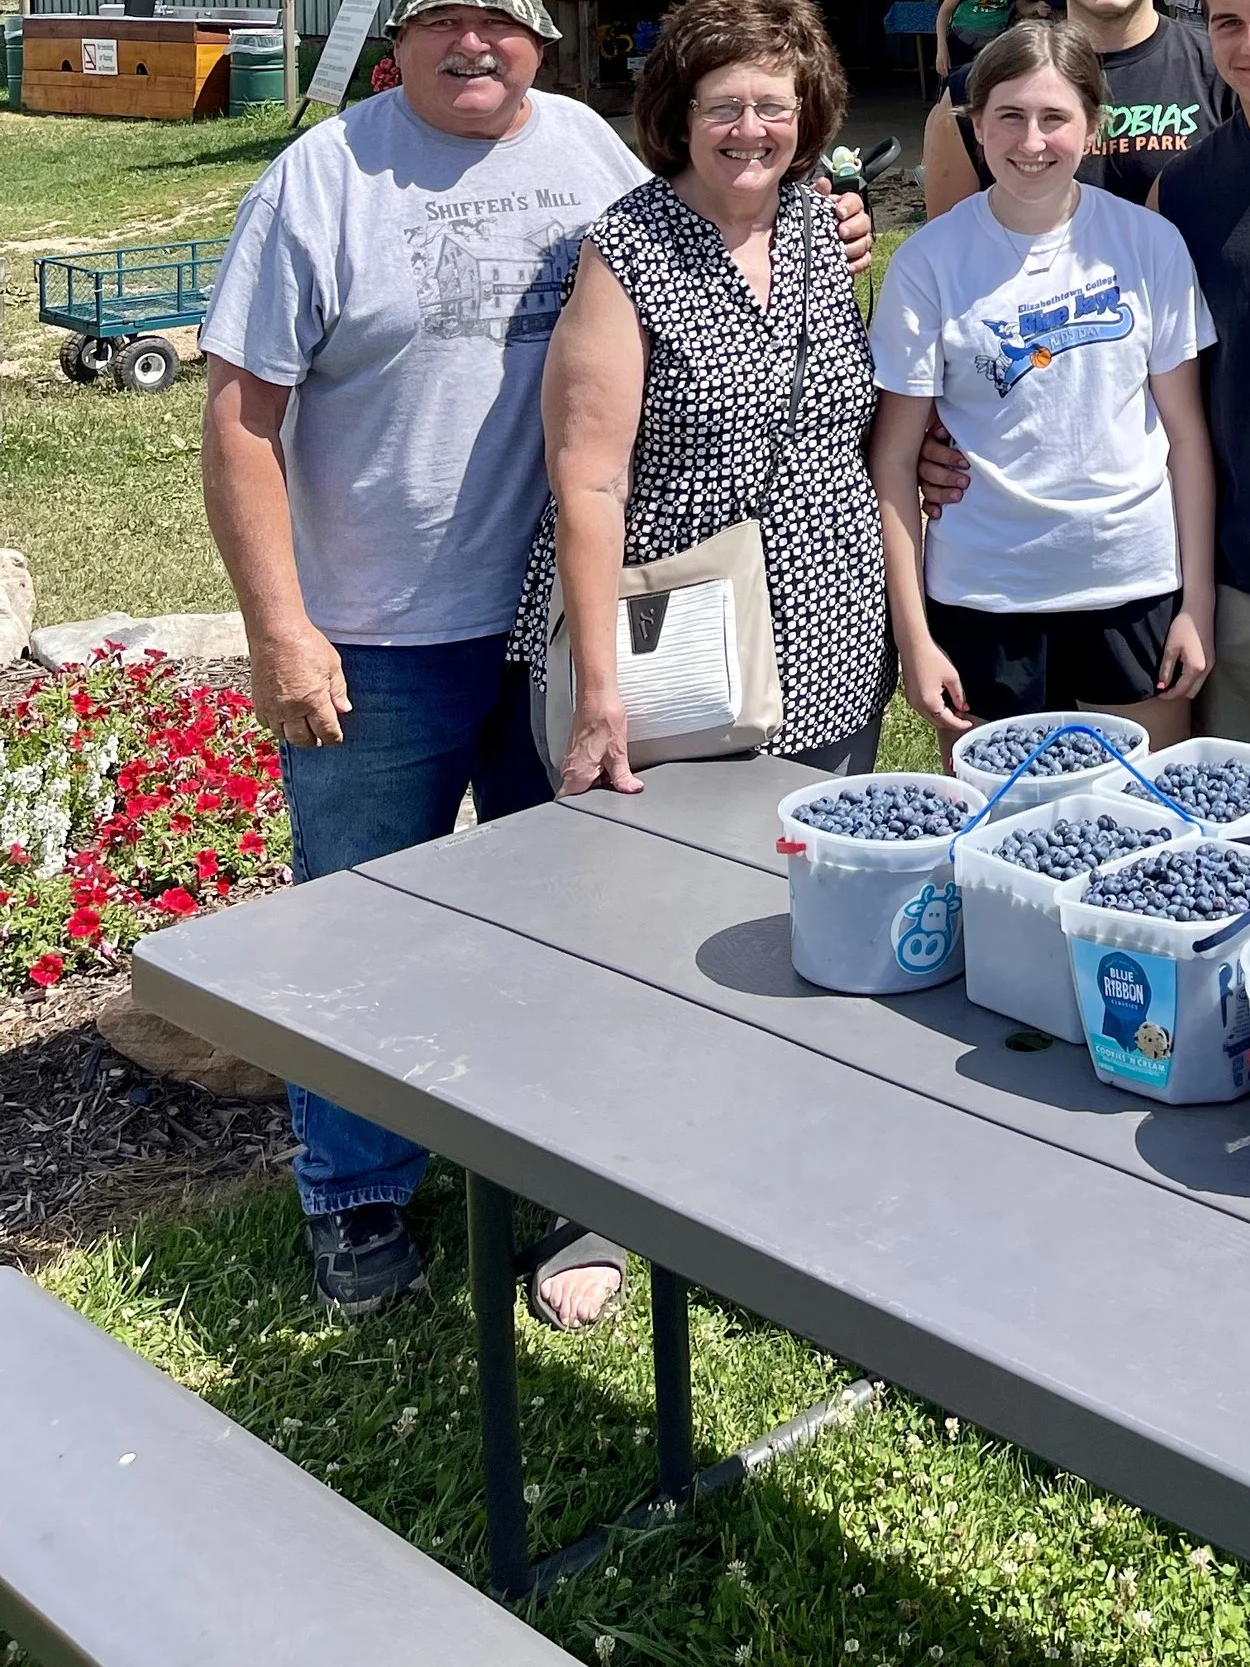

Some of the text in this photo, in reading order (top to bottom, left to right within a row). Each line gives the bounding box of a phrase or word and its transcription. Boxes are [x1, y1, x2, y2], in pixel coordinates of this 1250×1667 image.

[1135, 135, 1189, 152] PARK
[1110, 967, 1134, 983] BLUE
[1104, 976, 1144, 1005] RIBBON
[1096, 1045, 1126, 1063] COOKIES
[1137, 1059, 1166, 1072] CREAM
